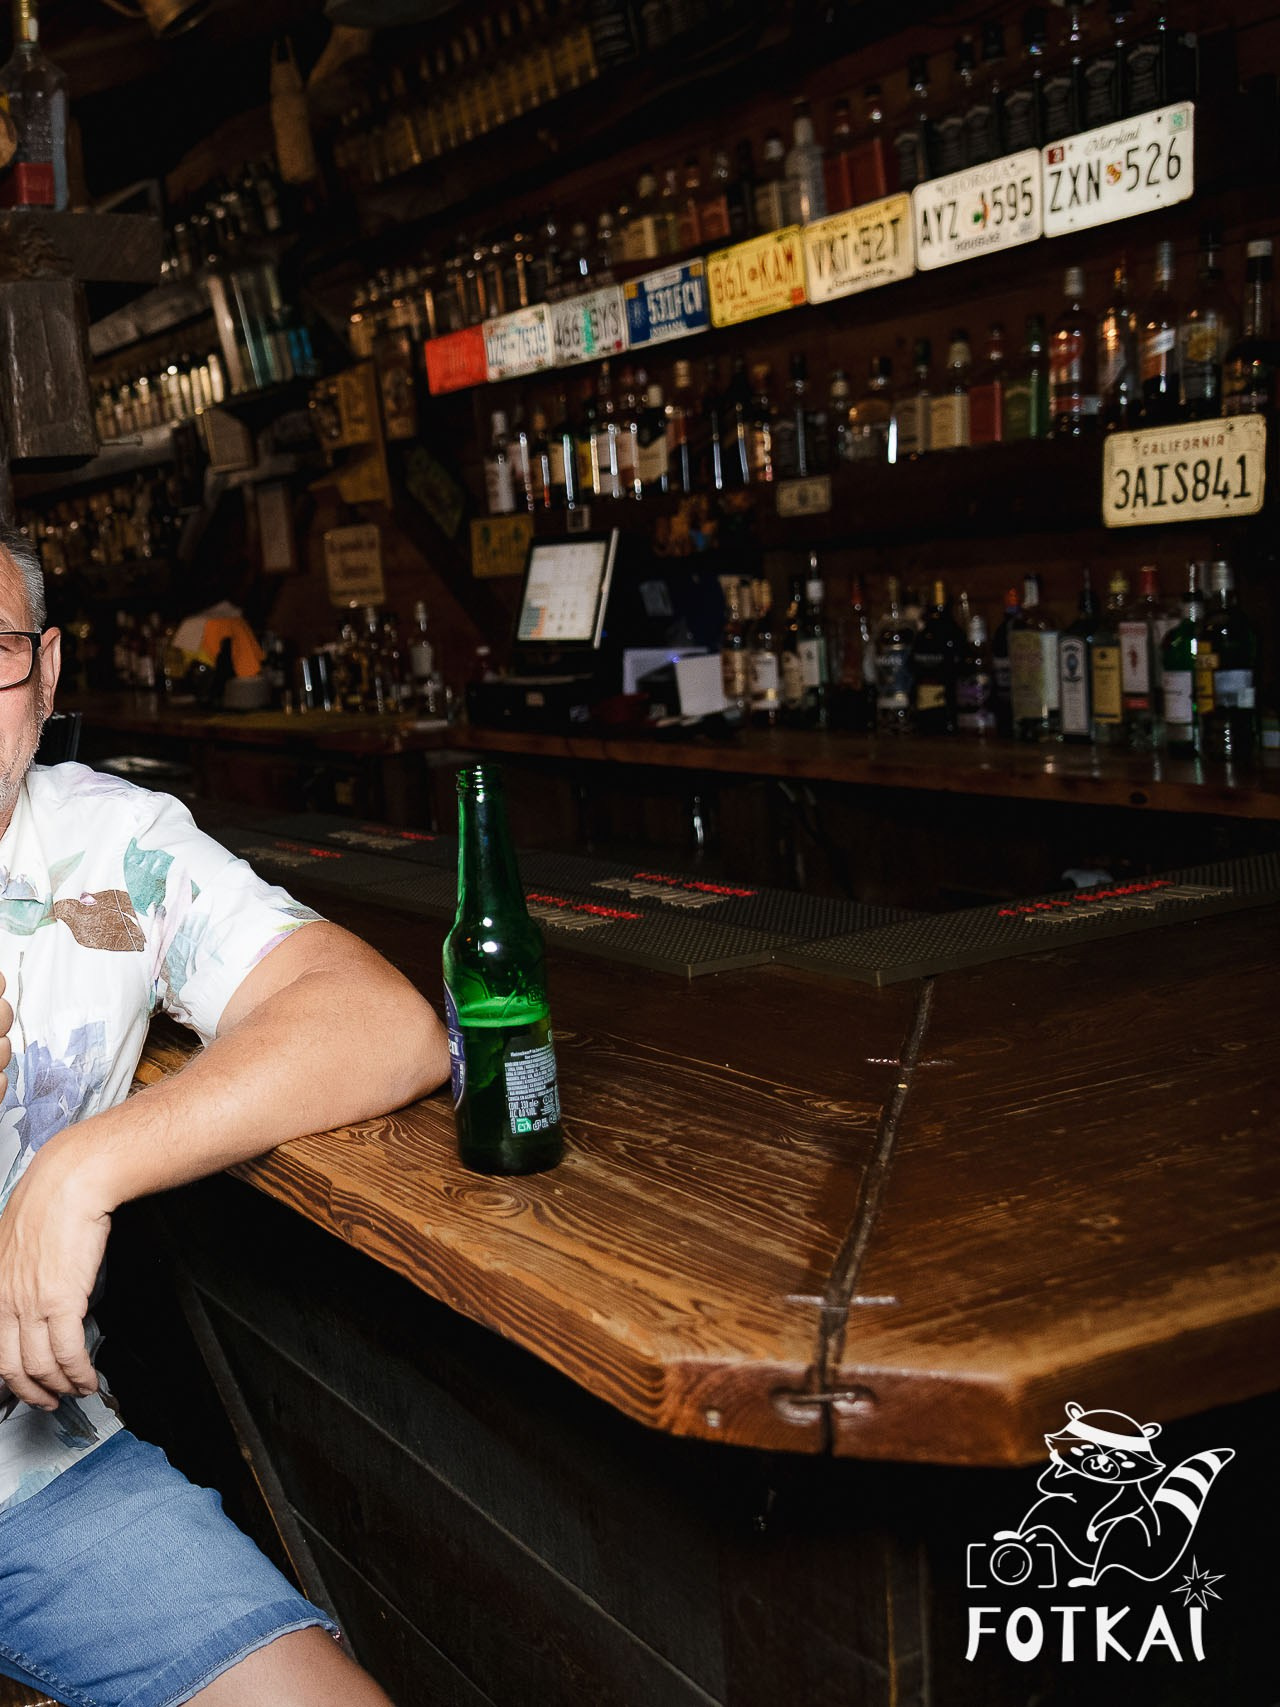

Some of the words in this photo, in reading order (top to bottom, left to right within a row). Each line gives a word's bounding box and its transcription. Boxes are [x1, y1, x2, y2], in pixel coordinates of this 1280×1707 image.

[1084, 122, 1142, 157] Maryland
[1048, 159, 1101, 213] ZXN
[1125, 137, 1182, 193] 526
[921, 201, 959, 248] AYZ
[1141, 433, 1225, 456] CALIFORNIA
[1114, 454, 1252, 510] 3AIS841
